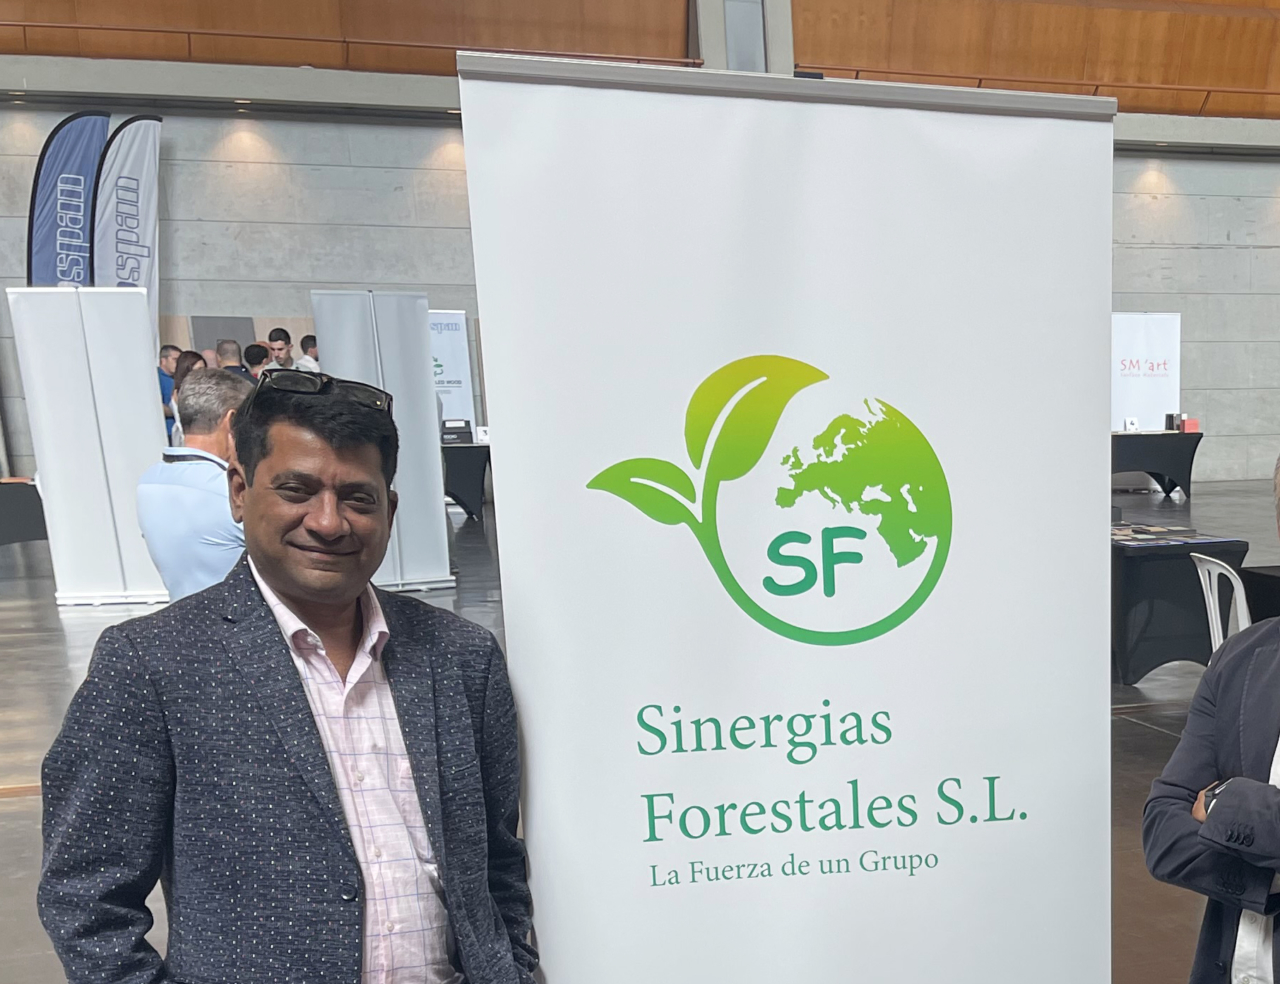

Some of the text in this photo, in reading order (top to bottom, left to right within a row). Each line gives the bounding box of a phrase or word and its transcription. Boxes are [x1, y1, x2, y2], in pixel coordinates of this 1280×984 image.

[763, 526, 867, 597] SF
[636, 699, 893, 765] Sinergias
[640, 776, 1028, 843] Forestales S.L.
[650, 850, 939, 887] La Fuerza de un Grupo
